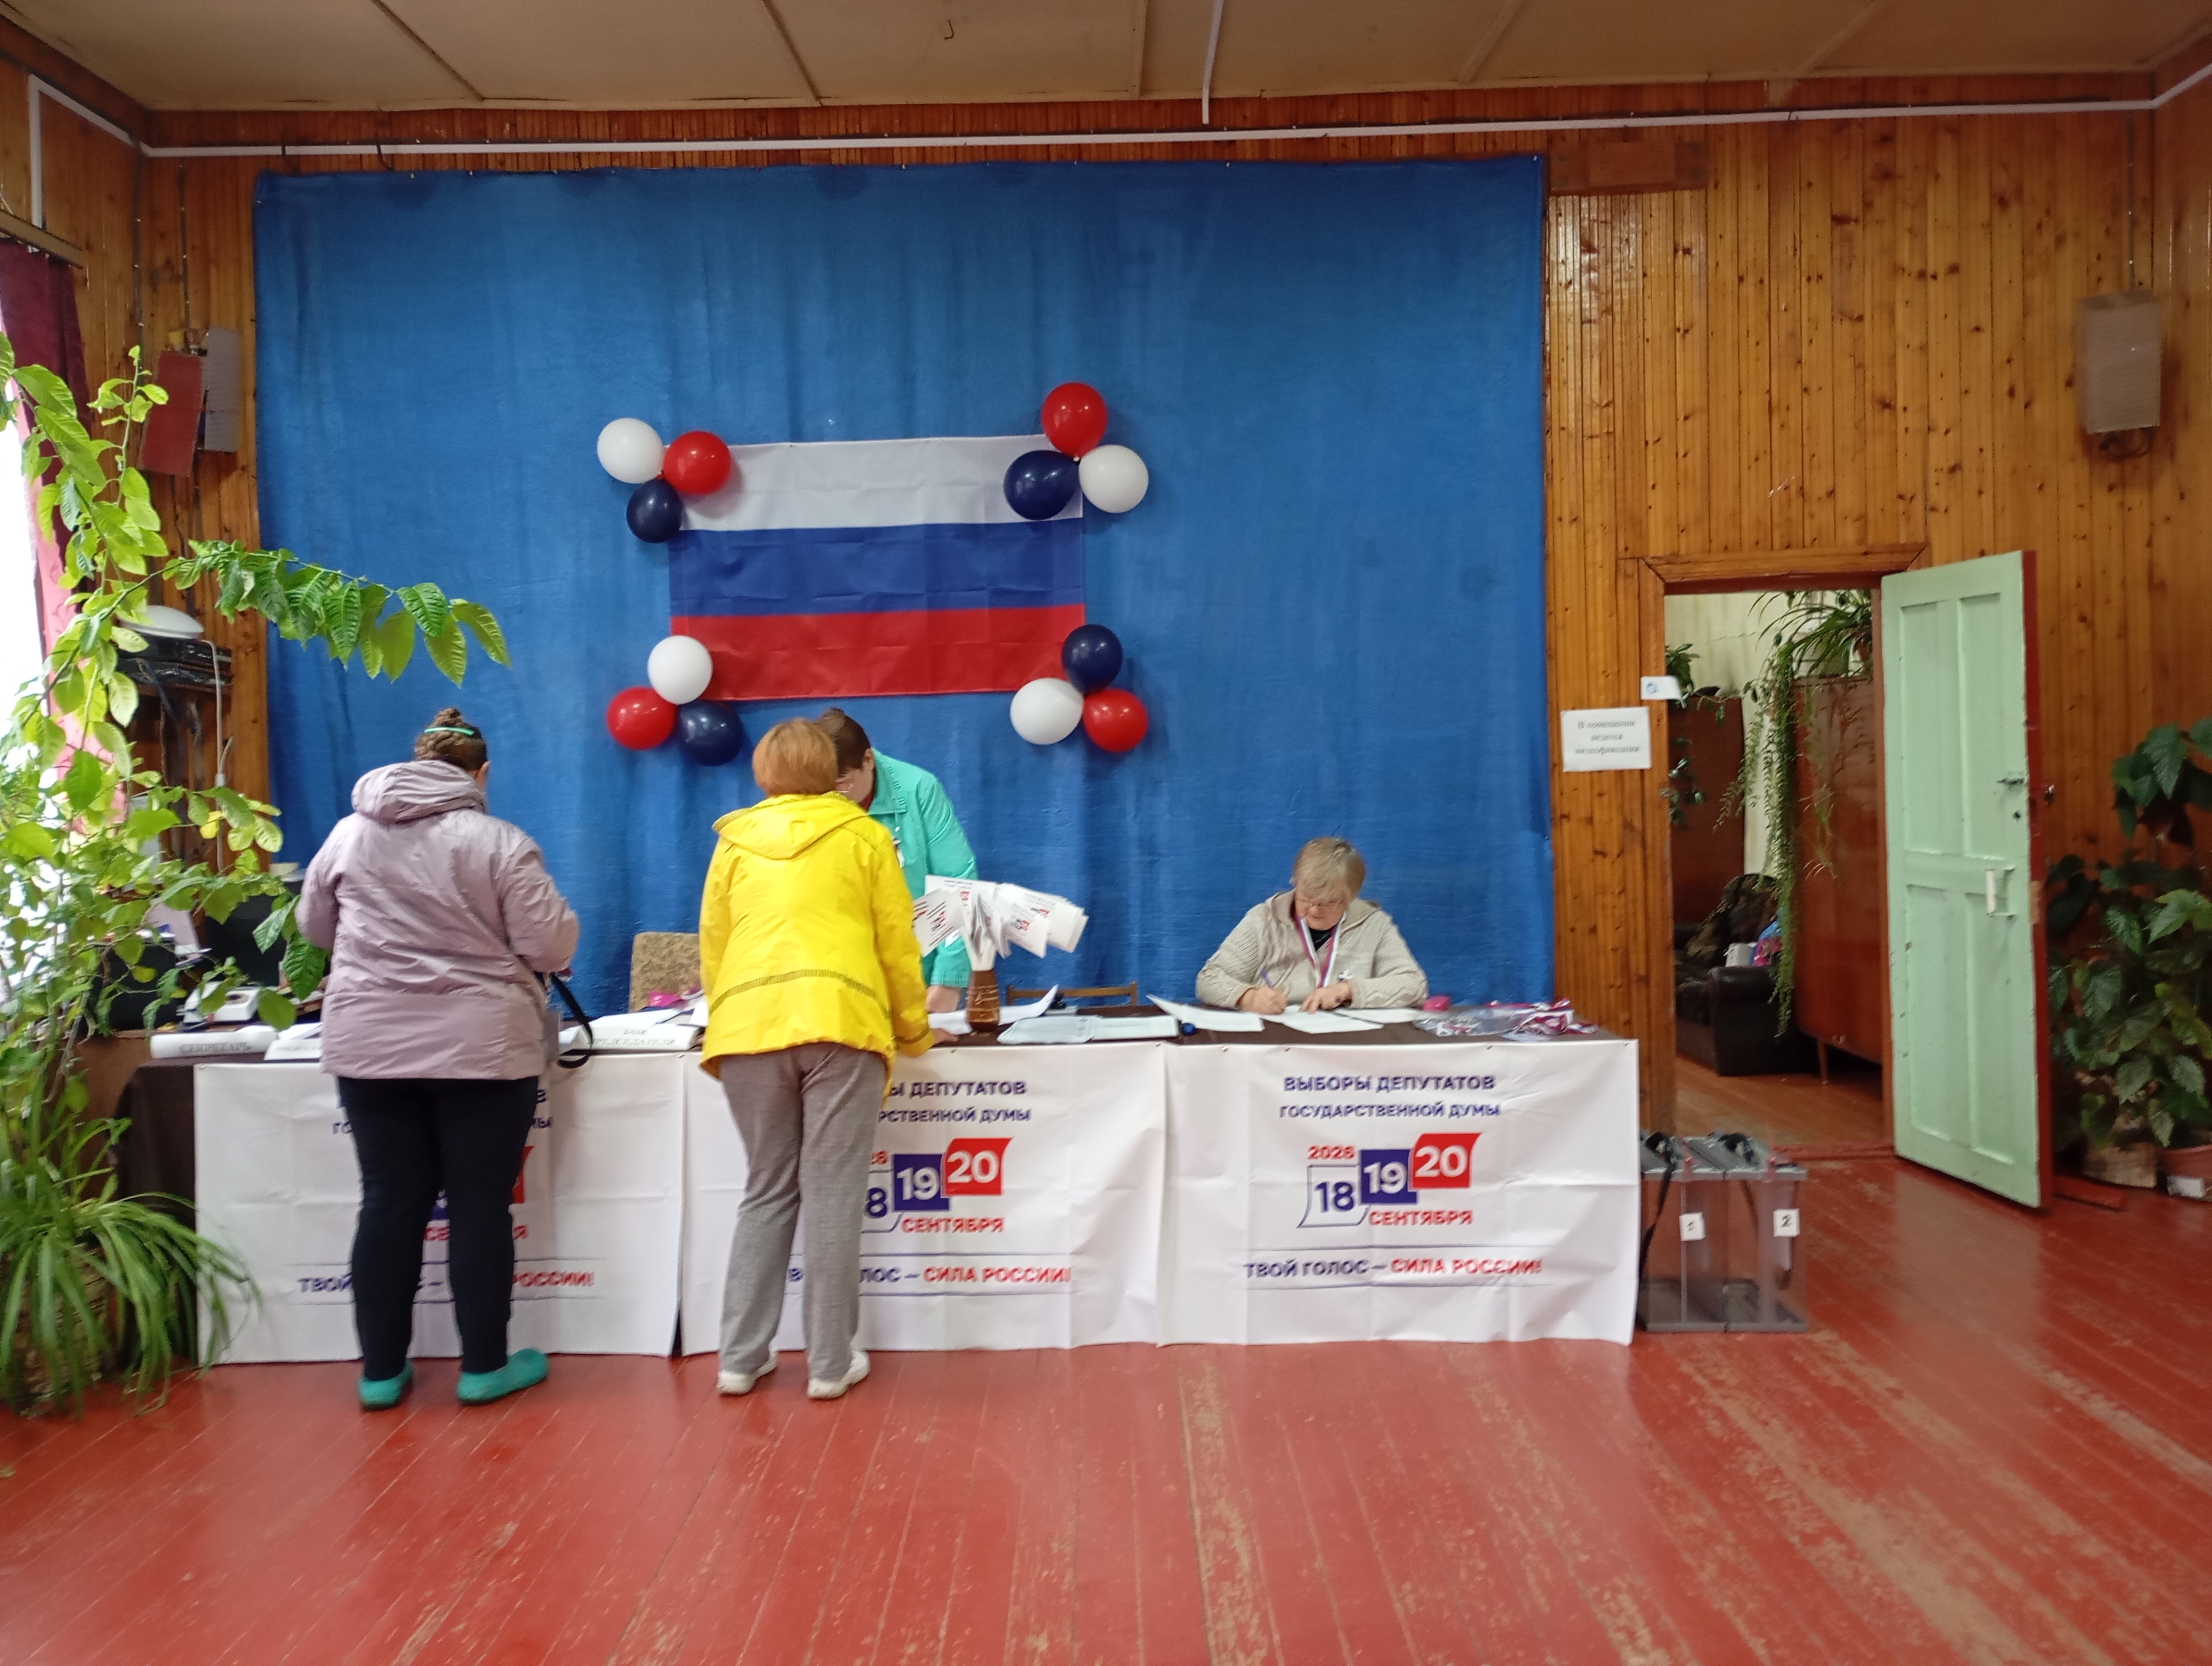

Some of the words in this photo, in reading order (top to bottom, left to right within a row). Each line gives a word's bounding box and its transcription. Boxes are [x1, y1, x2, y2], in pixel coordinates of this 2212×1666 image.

[909, 1081, 1028, 1099] ДЕПУТАТОВ
[1283, 1076, 1372, 1091] ВЫБОРЫ
[1375, 1074, 1497, 1093] ДЕПУТАТОВ
[878, 1106, 976, 1123] РСТВЕННОЙ
[979, 1108, 1032, 1124] ДУМЫ
[1279, 1101, 1445, 1119] ГОСУДАРСТВЕННОЙ
[1448, 1103, 1501, 1119] ДУМЫ
[1307, 1145, 1355, 1160] 2026
[1414, 1144, 1468, 1178] 20
[947, 1149, 1000, 1184] 20
[896, 1167, 941, 1201] 19
[1363, 1161, 1408, 1194] 19
[865, 1188, 888, 1219] 8
[1314, 1181, 1355, 1213] 18
[901, 1217, 1005, 1233] СЕНТЯБРЯ
[1368, 1209, 1473, 1226] СЕНТЯБРЯ
[1781, 1213, 1793, 1227] 2
[923, 1266, 976, 1283] СИЛА
[982, 1266, 1071, 1283] РОССИИ!
[1245, 1258, 1297, 1278] ТВОЙ
[1302, 1259, 1369, 1276] ГОЛОС
[1390, 1258, 1446, 1274] СИЛА
[1451, 1258, 1542, 1275] РОССИИ!
